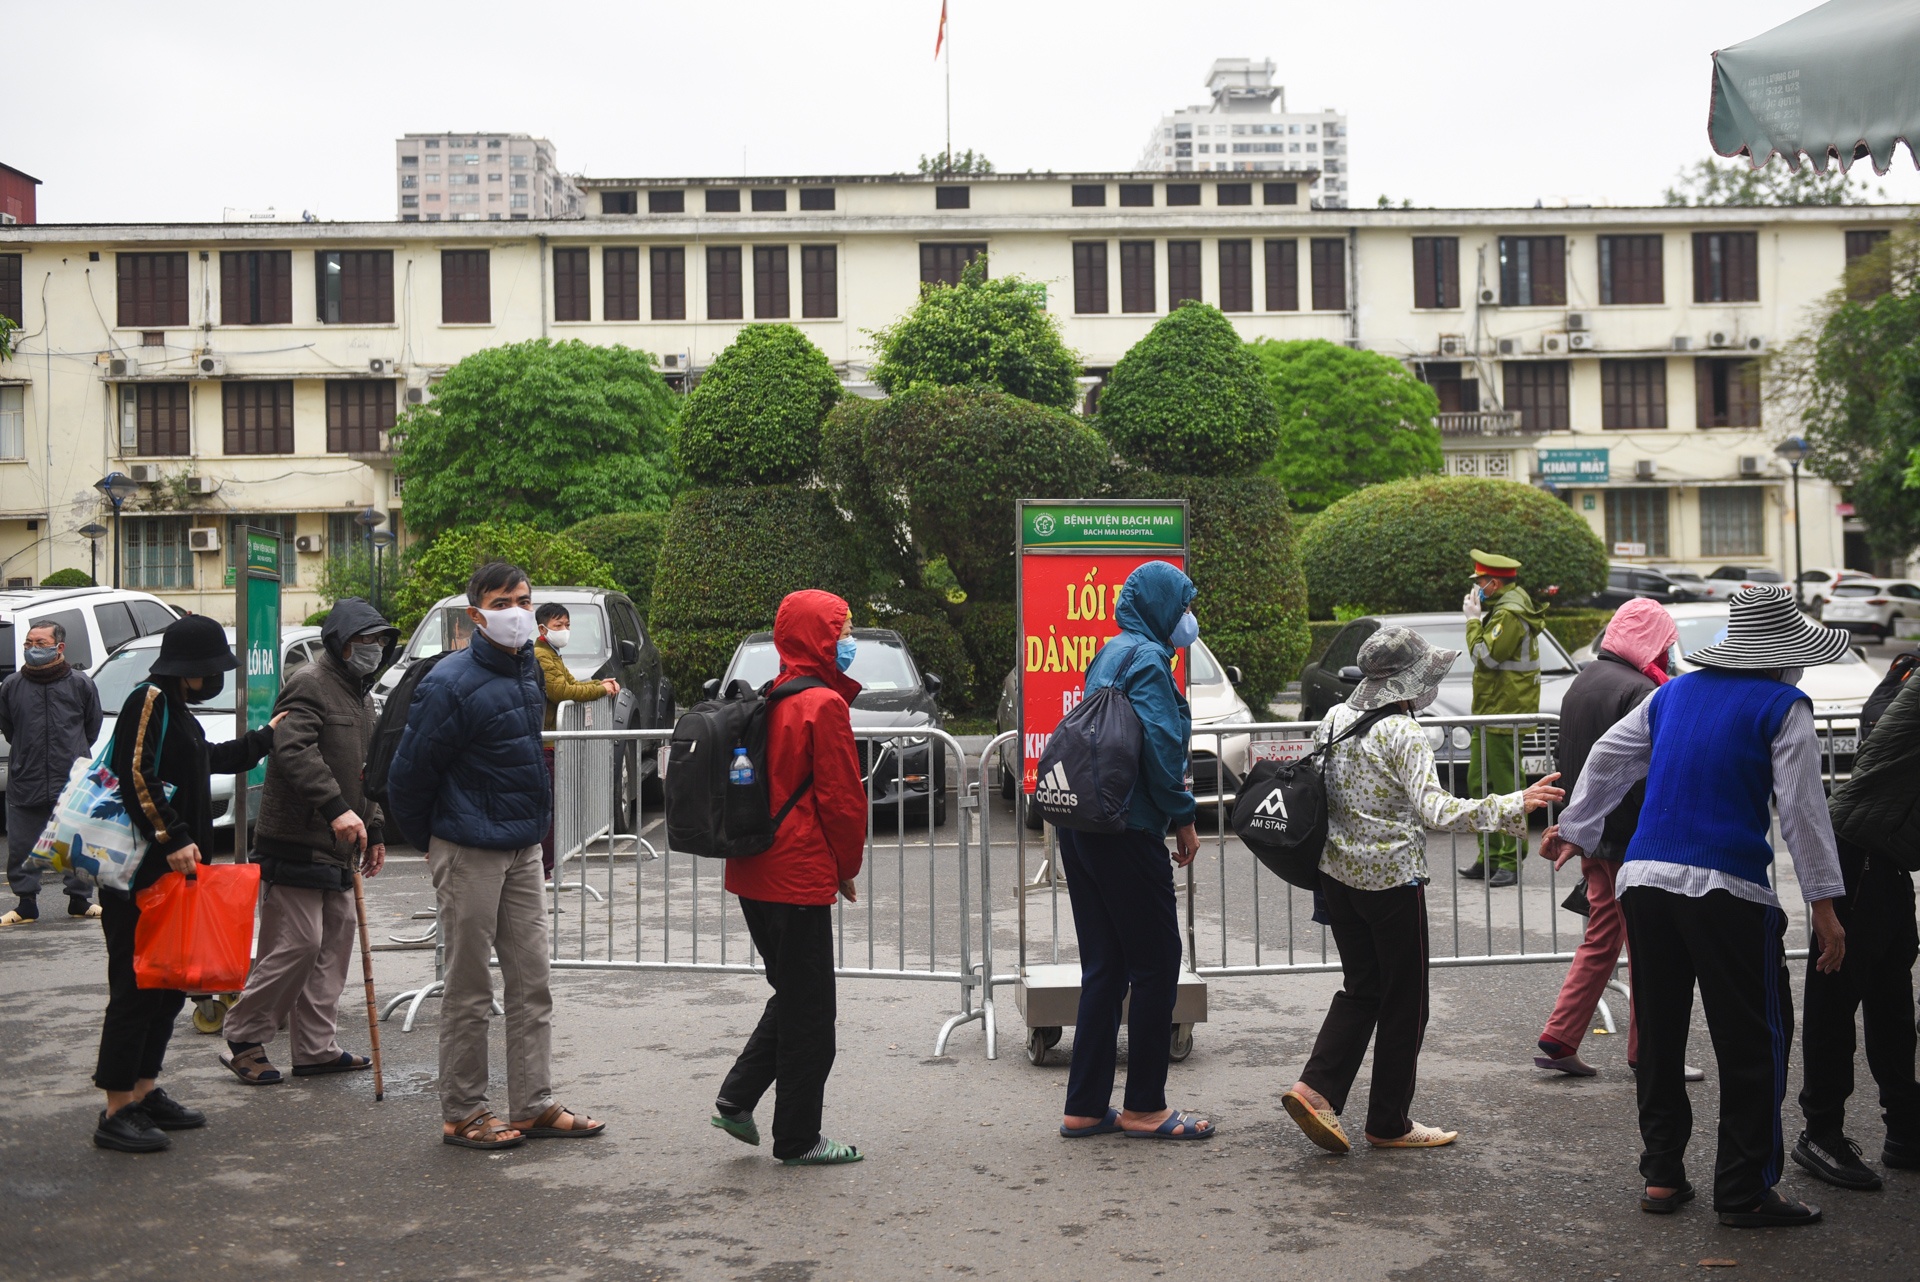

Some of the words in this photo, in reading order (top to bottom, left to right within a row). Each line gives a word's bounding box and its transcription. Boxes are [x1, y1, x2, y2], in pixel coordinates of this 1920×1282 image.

[1543, 459, 1577, 473] KHÁM
[1063, 514, 1093, 528] BỆNH
[1095, 514, 1119, 528] VIỆN
[1122, 515, 1151, 528] BẠCH
[1153, 515, 1174, 525] MAI
[1066, 566, 1107, 621] LỐI
[1025, 624, 1097, 673] DÀNH
[248, 640, 261, 676] LỐI
[262, 649, 274, 676] RA
[1270, 744, 1303, 752] C.A.H.N
[1036, 788, 1079, 807] adidas
[1043, 805, 1072, 814] RUNNING
[1250, 818, 1264, 828] AM
[1264, 820, 1287, 832] STAR
